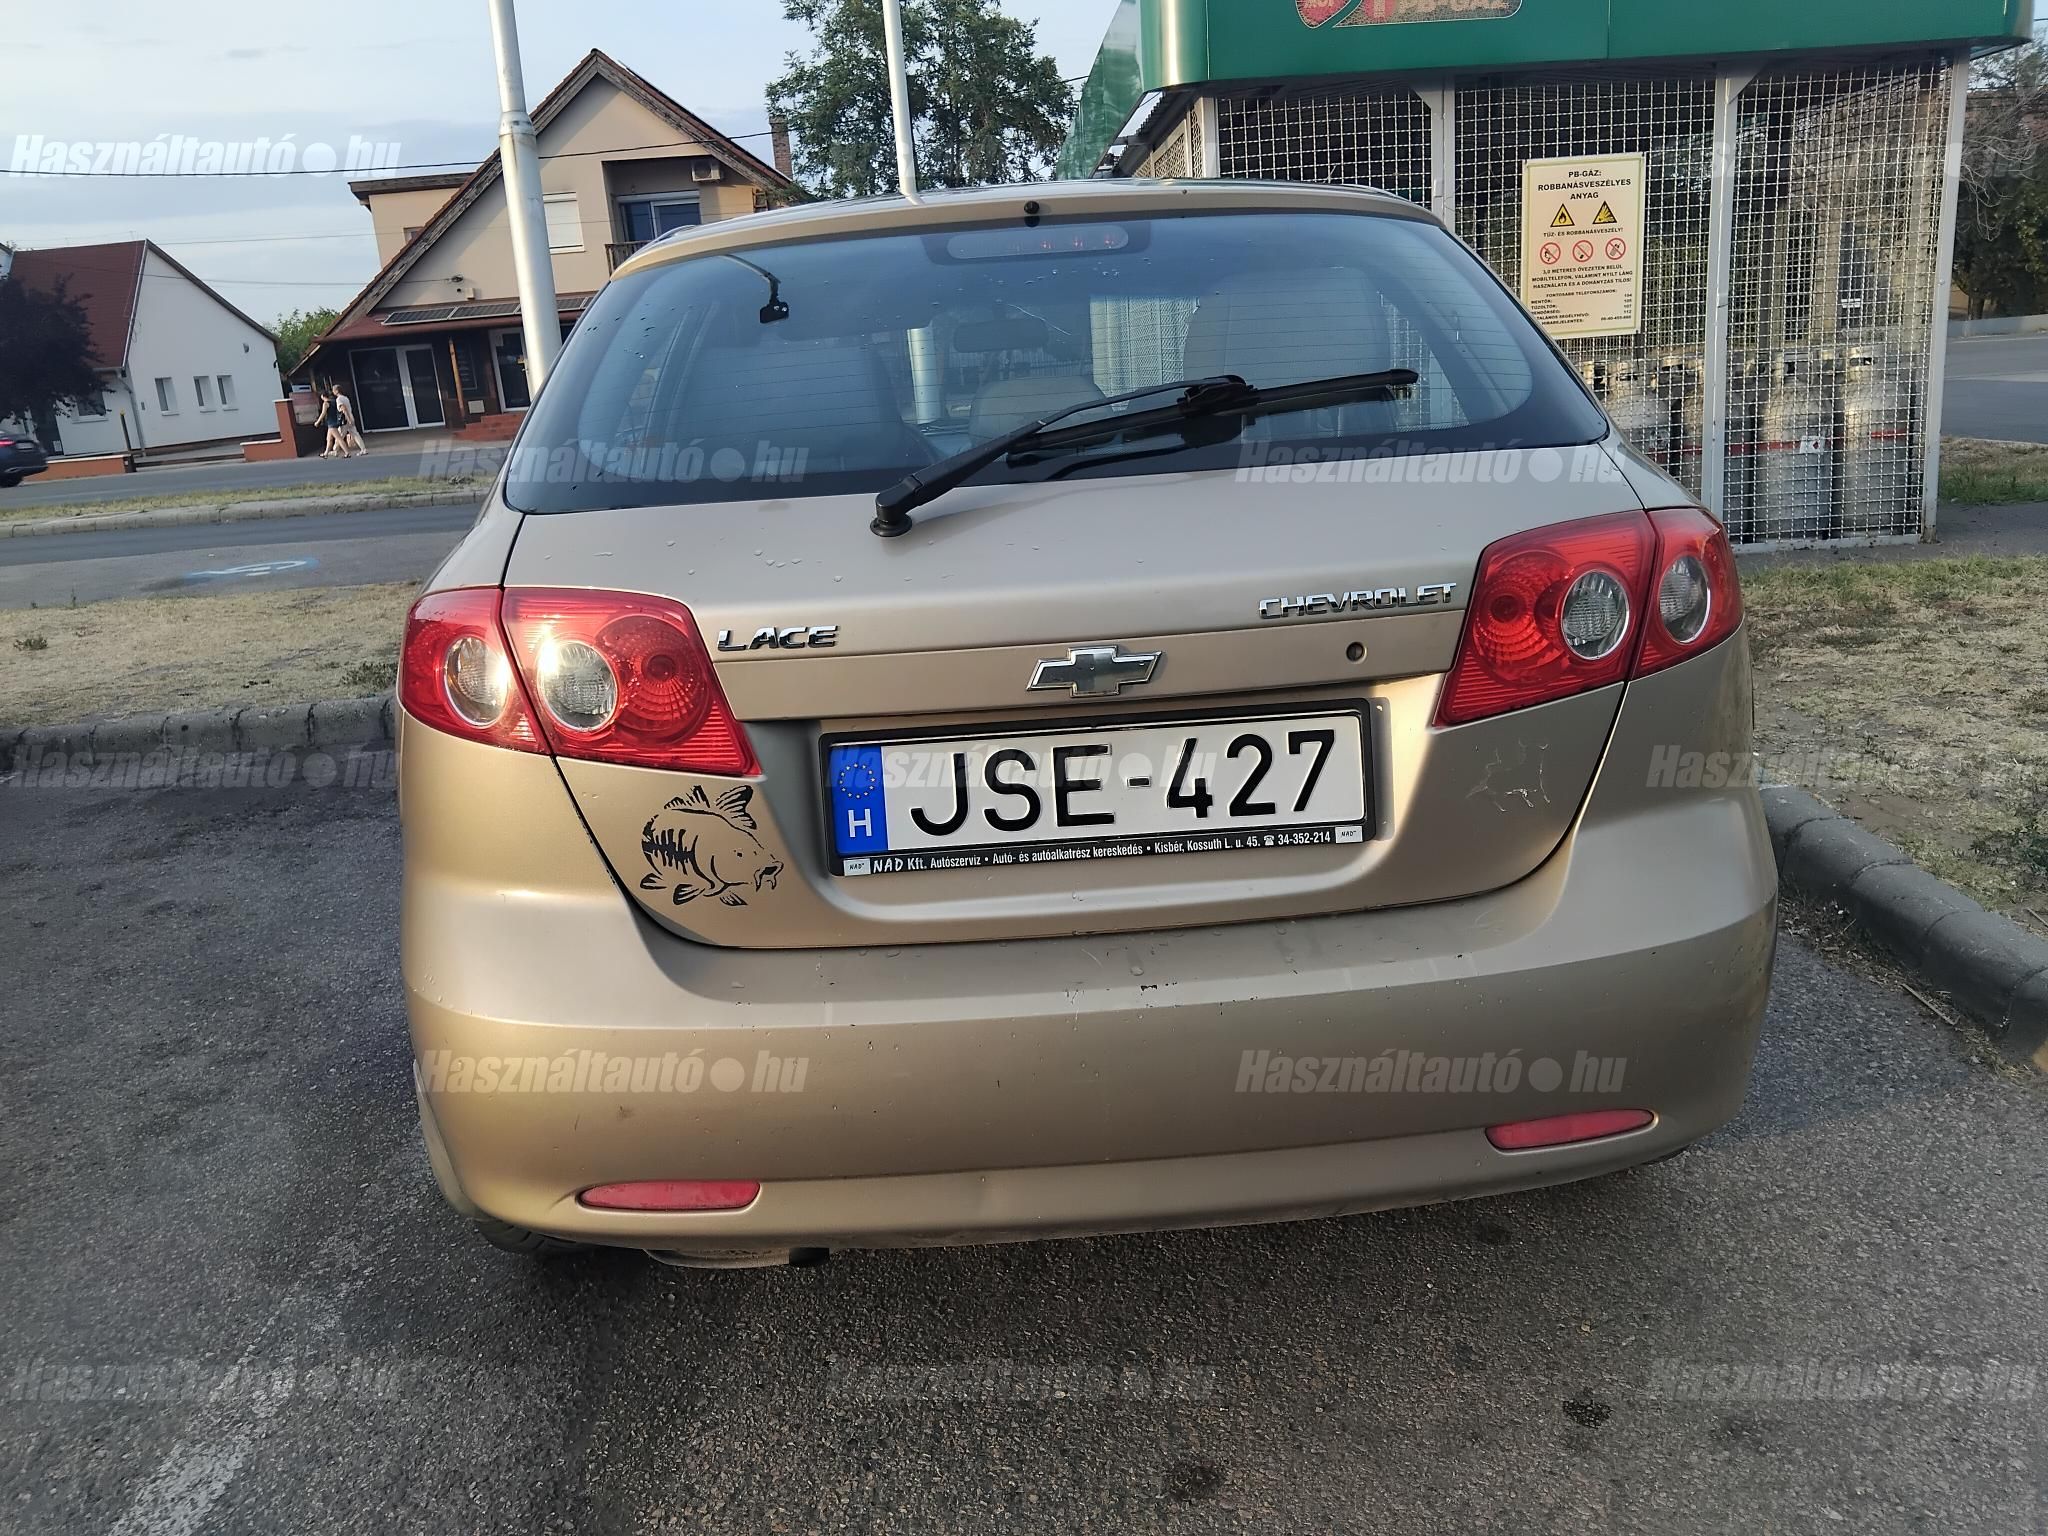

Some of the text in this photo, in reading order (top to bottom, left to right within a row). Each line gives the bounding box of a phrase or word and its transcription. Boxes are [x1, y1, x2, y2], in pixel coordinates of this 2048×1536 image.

[1538, 178, 1631, 191] ROBBANÁSVESZÉLYES
[1568, 169, 1602, 178] PB-GÁZ:
[1570, 192, 1599, 200] ANYAG
[1259, 582, 1457, 620] CHEVROLET
[717, 625, 839, 651] LACE
[910, 728, 1337, 837] JSE-427
[848, 807, 873, 838] H
[873, 831, 1331, 873] NAD Kft. Autószerviz Autó- és autóalkatrész kereskedés Kisbér, Kossuth L. u. 45. 34-352-214
